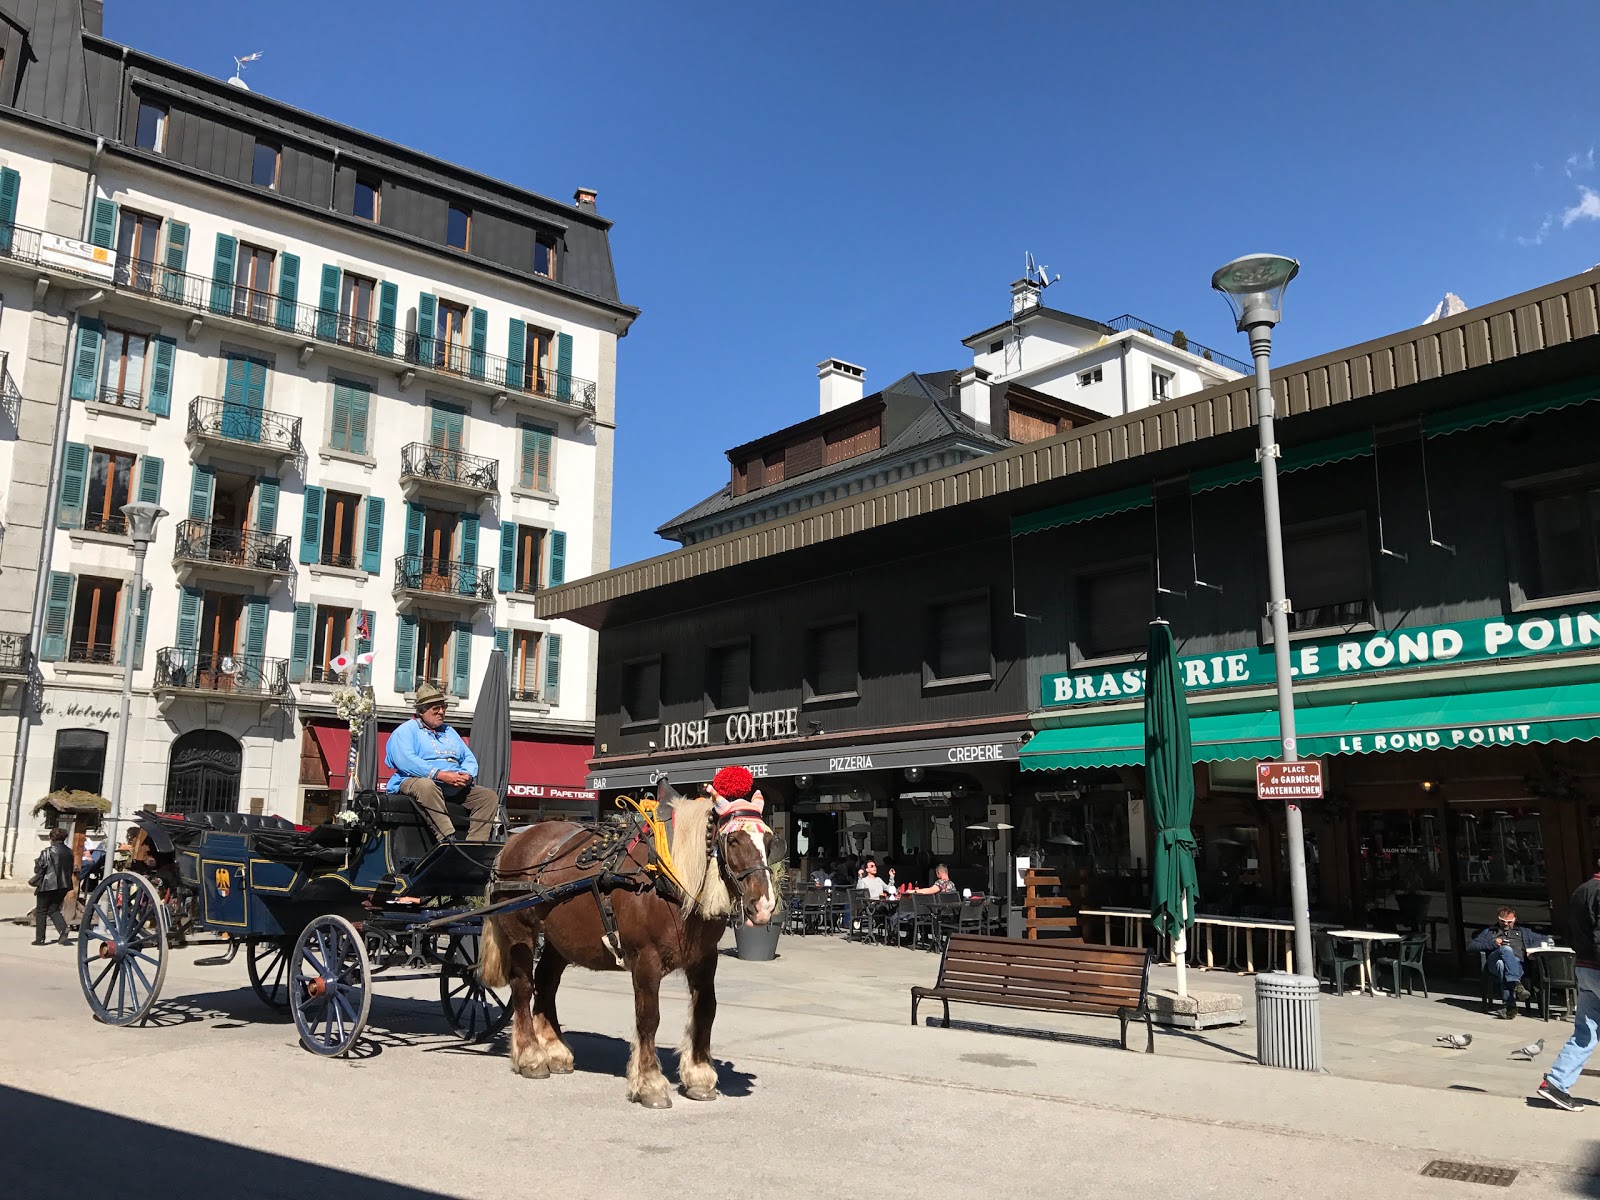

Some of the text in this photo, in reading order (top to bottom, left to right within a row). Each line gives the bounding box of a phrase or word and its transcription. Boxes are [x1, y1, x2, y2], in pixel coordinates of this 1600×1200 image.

[52, 235, 92, 254] TCE
[1053, 653, 1250, 702] BRASRIE
[1337, 629, 1463, 672] ROND
[1484, 611, 1600, 655] POIN
[664, 707, 799, 749] IRISH COFFEE
[1340, 724, 1531, 751] LE ROND POINT
[948, 744, 1004, 762] CREPERIE
[829, 755, 873, 771] PIZZERIA
[593, 777, 607, 789] BAR
[1280, 775, 1320, 784] GARMISCH
[507, 785, 596, 799] NDRU PAPETERIE
[1260, 786, 1320, 795] PARTENKIRCHEN
